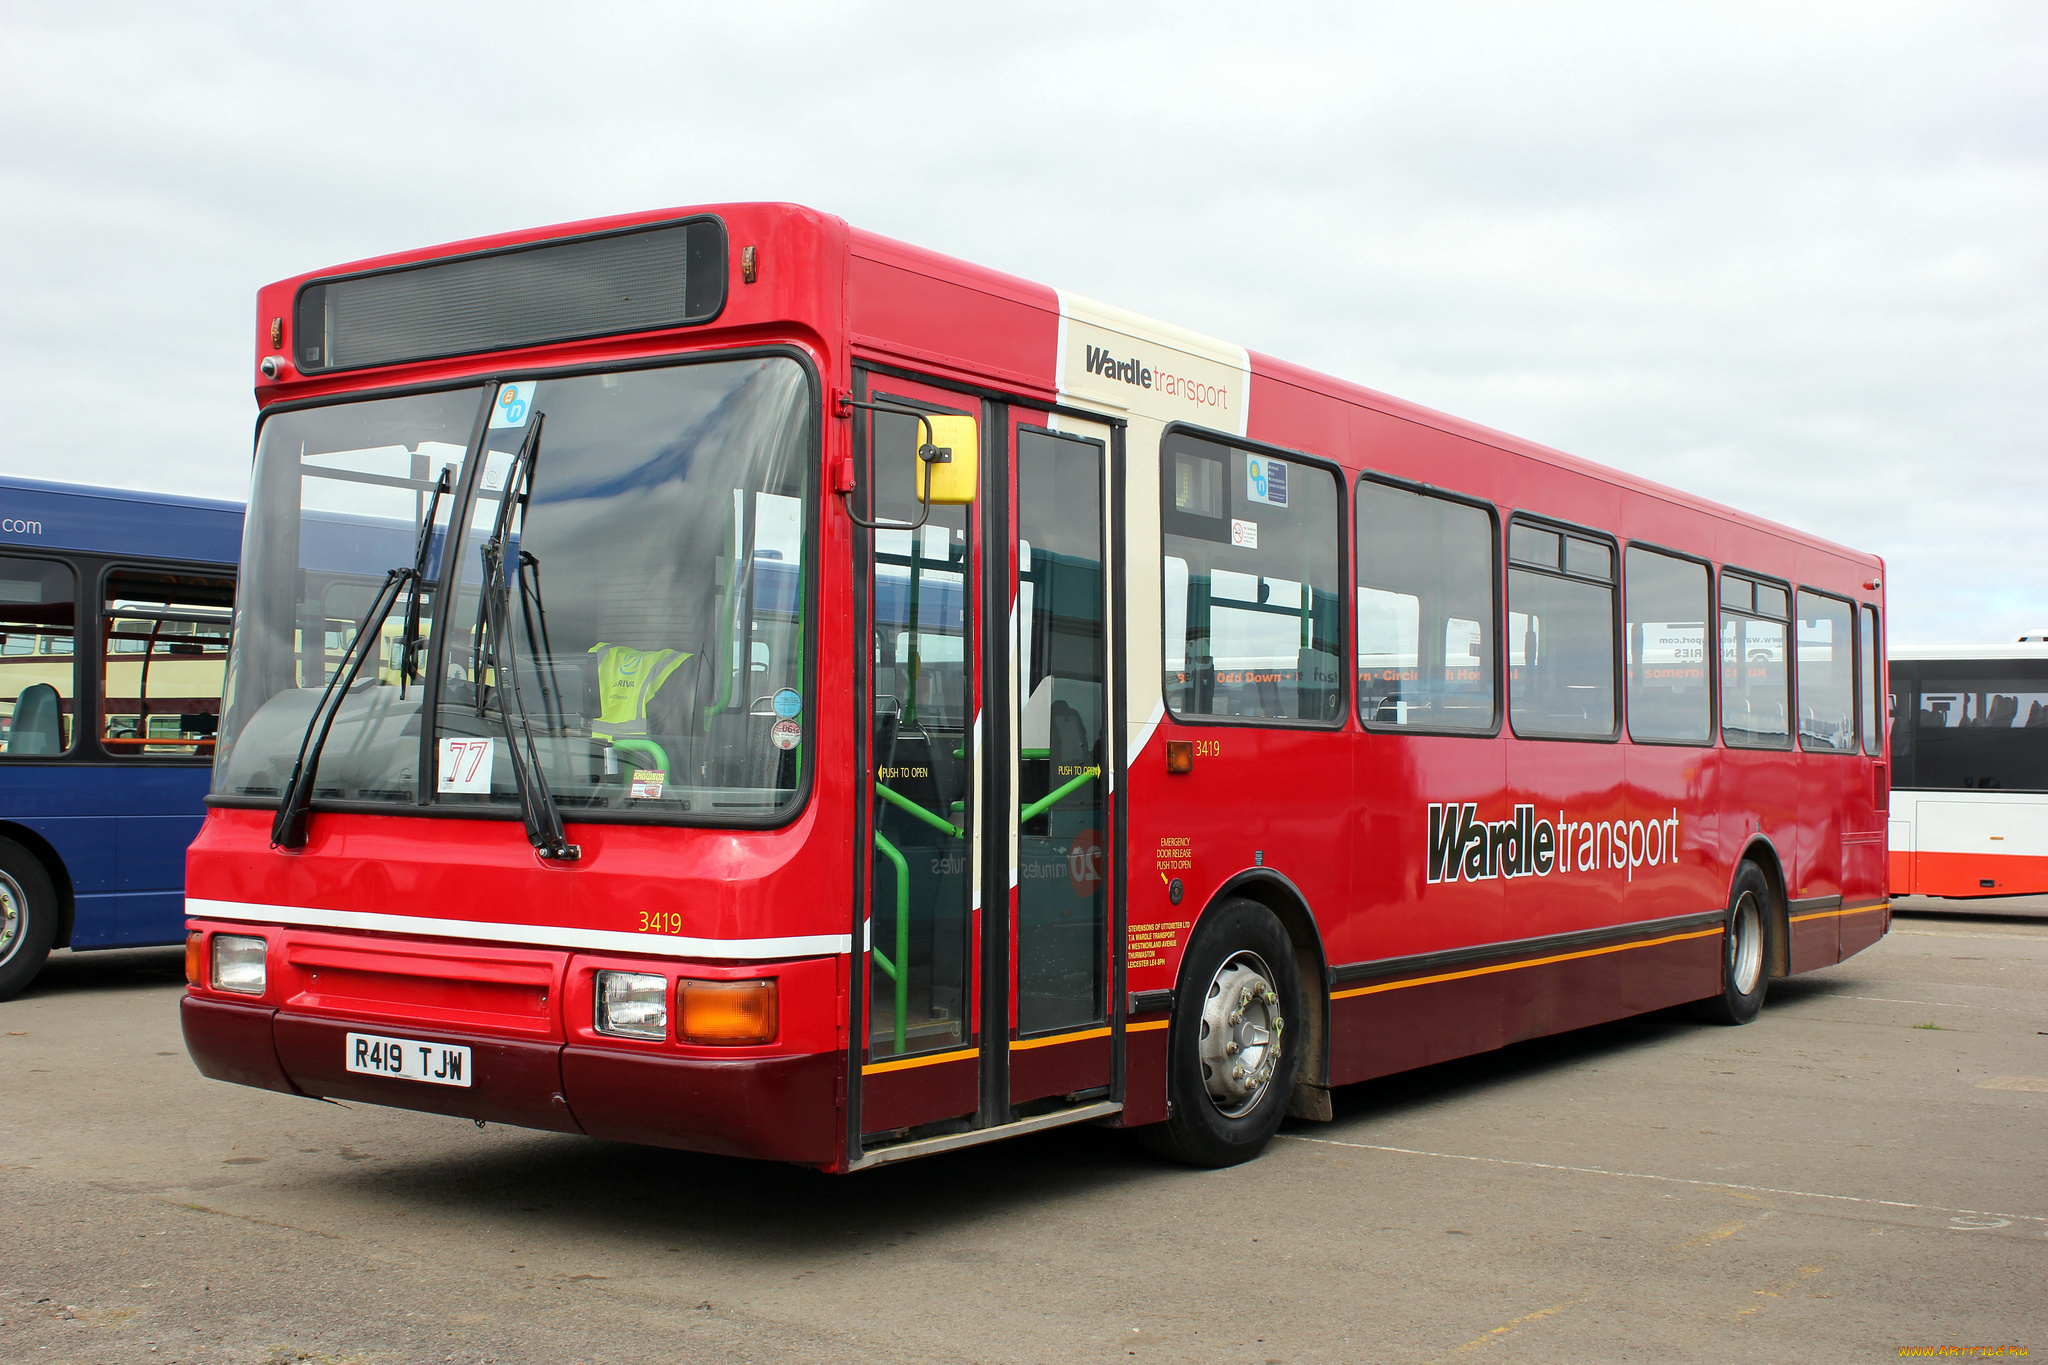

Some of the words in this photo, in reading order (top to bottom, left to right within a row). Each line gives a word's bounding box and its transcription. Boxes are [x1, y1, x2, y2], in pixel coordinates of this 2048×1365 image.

[1086, 344, 1152, 389] Wardle
[1153, 365, 1228, 410] transport
[2, 518, 42, 535] com
[1216, 672, 1242, 683] Odd
[1245, 673, 1282, 683] Down
[1195, 740, 1220, 757] 3419
[449, 741, 488, 782] 77
[882, 767, 899, 778] PUSH
[900, 767, 910, 778] TO
[911, 767, 928, 778] OPEN
[1057, 765, 1073, 776] PUSH
[1074, 766, 1082, 776] TO
[1083, 766, 1098, 776] OPEN
[1160, 837, 1191, 847] EMERGENCY
[1427, 802, 1556, 884] Wardle
[1557, 807, 1679, 883] transport
[1156, 849, 1172, 859] DOOR
[1172, 848, 1192, 858] RELEASE
[1156, 861, 1170, 870] PUSH
[1171, 860, 1178, 870] TO
[1178, 860, 1192, 869] OPEN
[638, 911, 681, 934] 3419
[1128, 924, 1155, 933] STEVENSONS
[356, 1038, 403, 1073] R419
[419, 1046, 462, 1081] TJW
